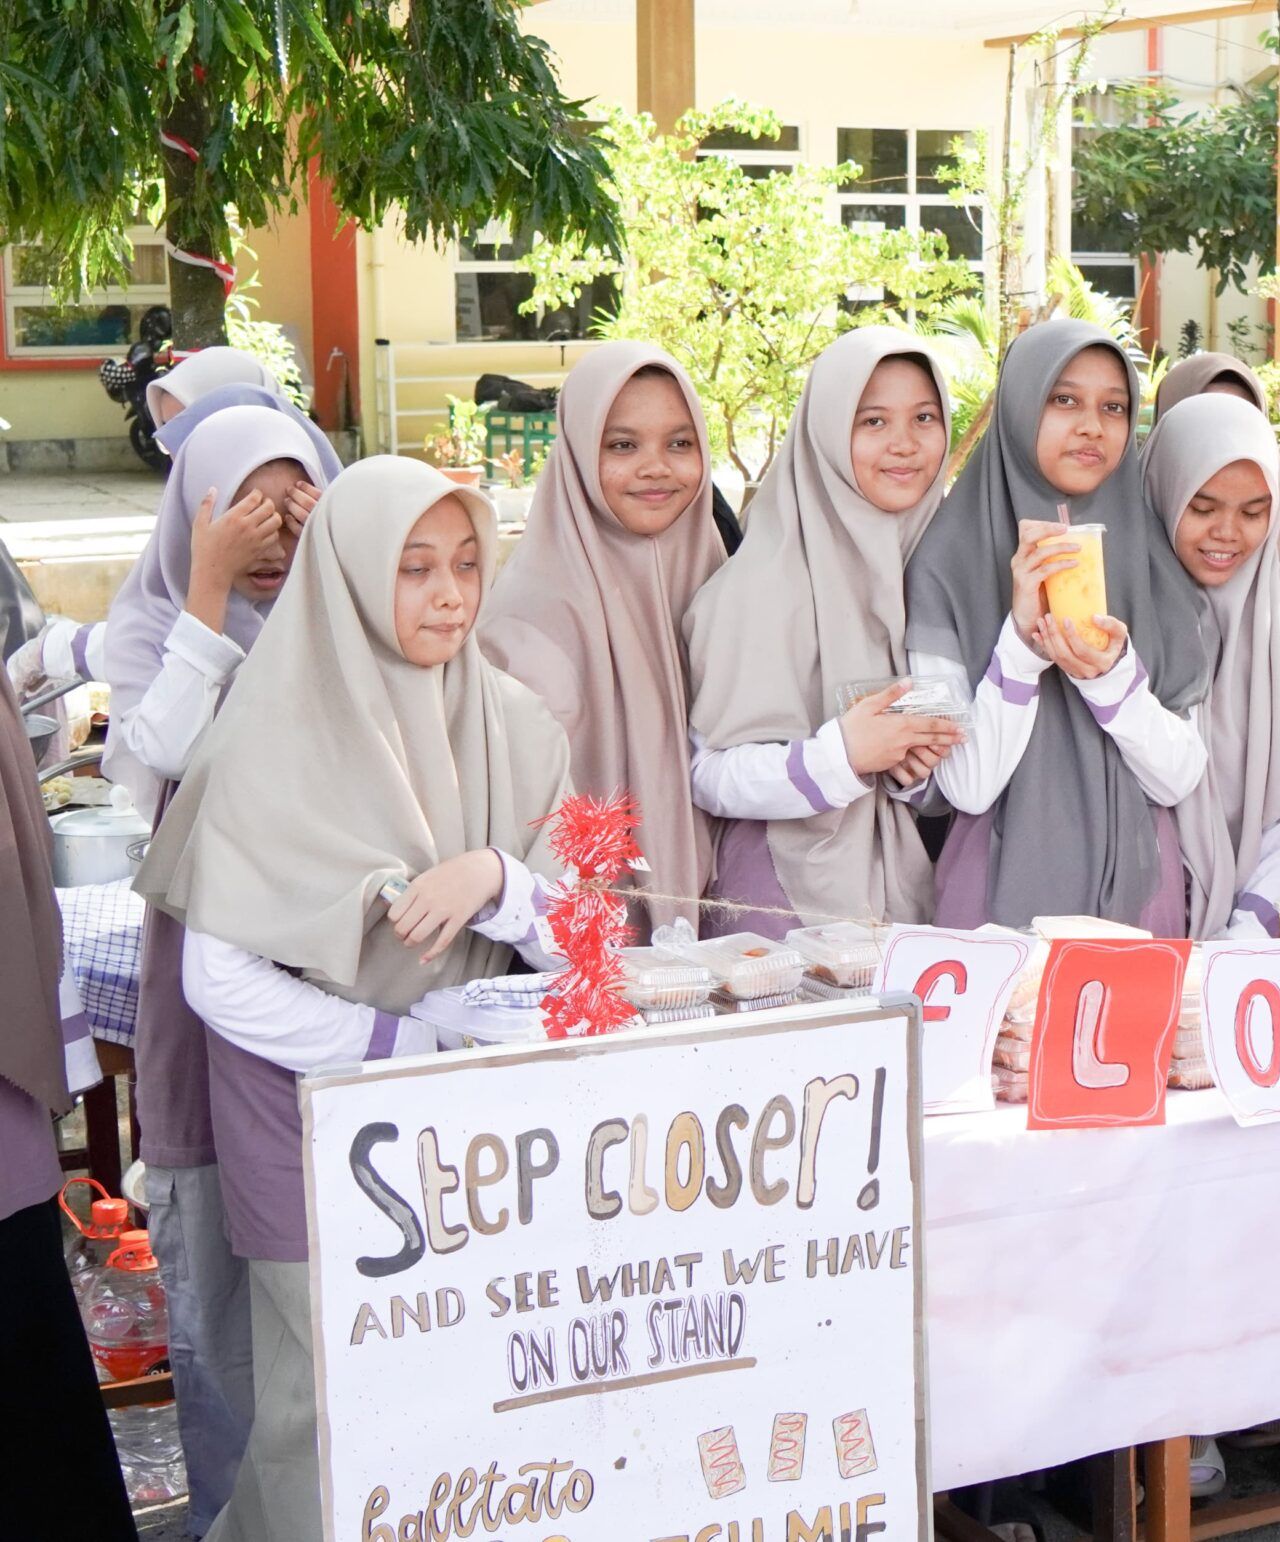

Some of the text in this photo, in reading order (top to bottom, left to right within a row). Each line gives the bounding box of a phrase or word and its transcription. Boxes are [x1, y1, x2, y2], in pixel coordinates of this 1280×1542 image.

[349, 1226, 910, 1345] AND SEE WHAT WE HAVE
[508, 1290, 746, 1394] ON OUR STAND
